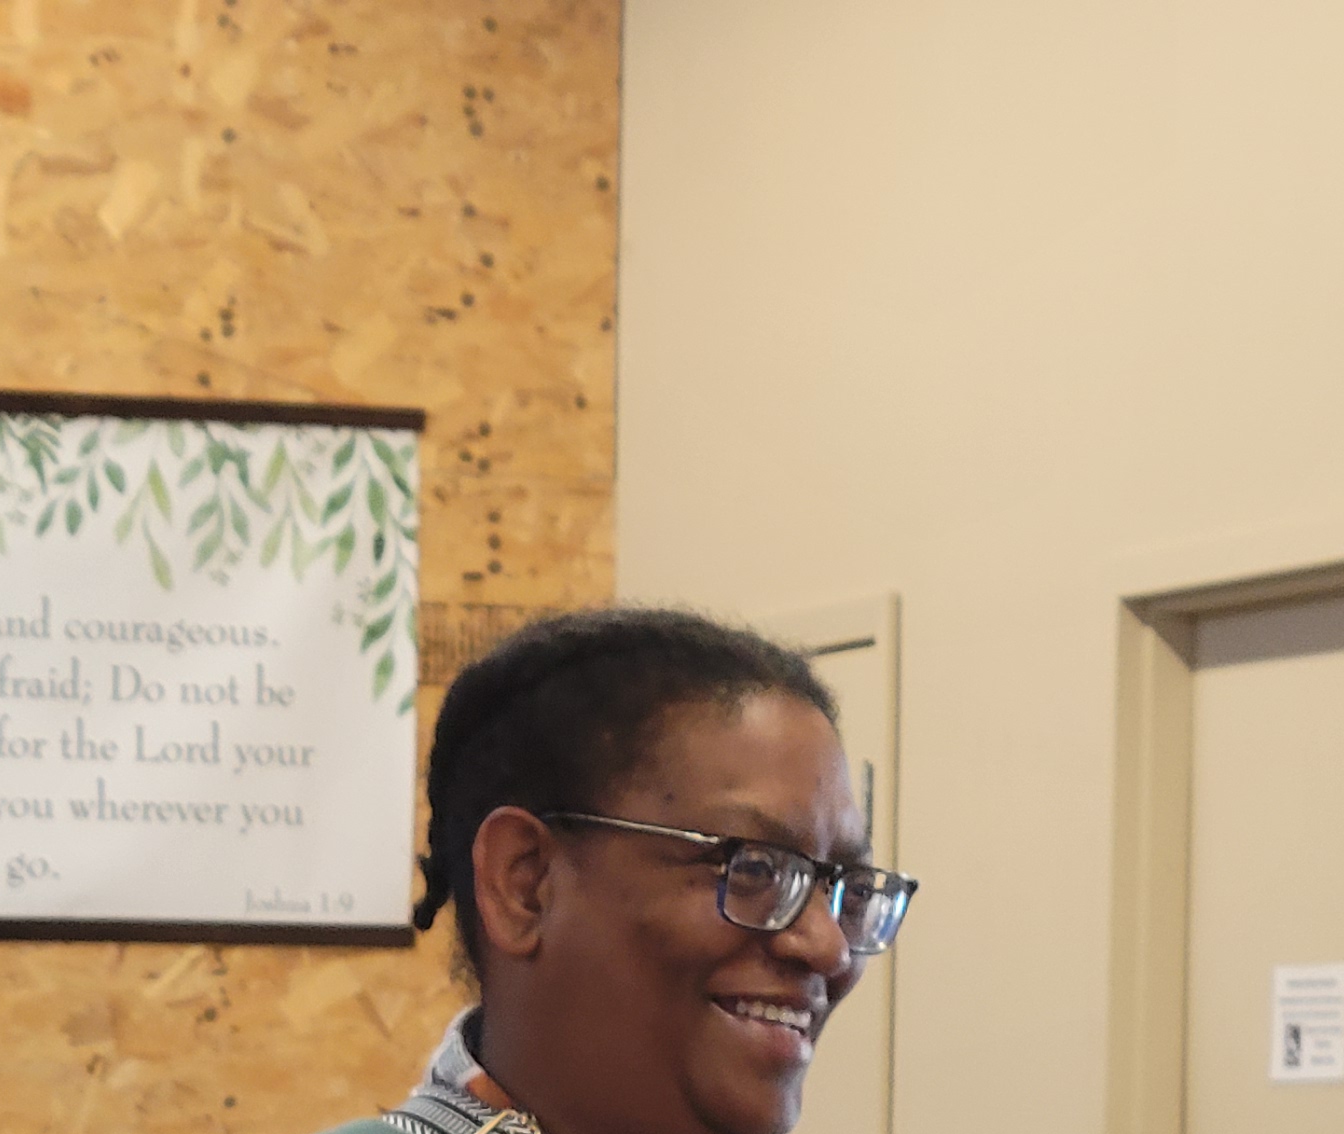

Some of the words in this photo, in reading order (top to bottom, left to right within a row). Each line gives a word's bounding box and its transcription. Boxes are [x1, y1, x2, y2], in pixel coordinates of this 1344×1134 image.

[63, 618, 281, 654] courageous.
[111, 663, 166, 704] Do
[179, 674, 240, 706] not
[255, 662, 296, 708] be
[60, 716, 119, 762] the
[134, 720, 221, 767] Lord
[232, 743, 316, 776] your
[68, 776, 229, 826] wherever
[238, 803, 304, 836] you
[6, 853, 62, 890] go.
